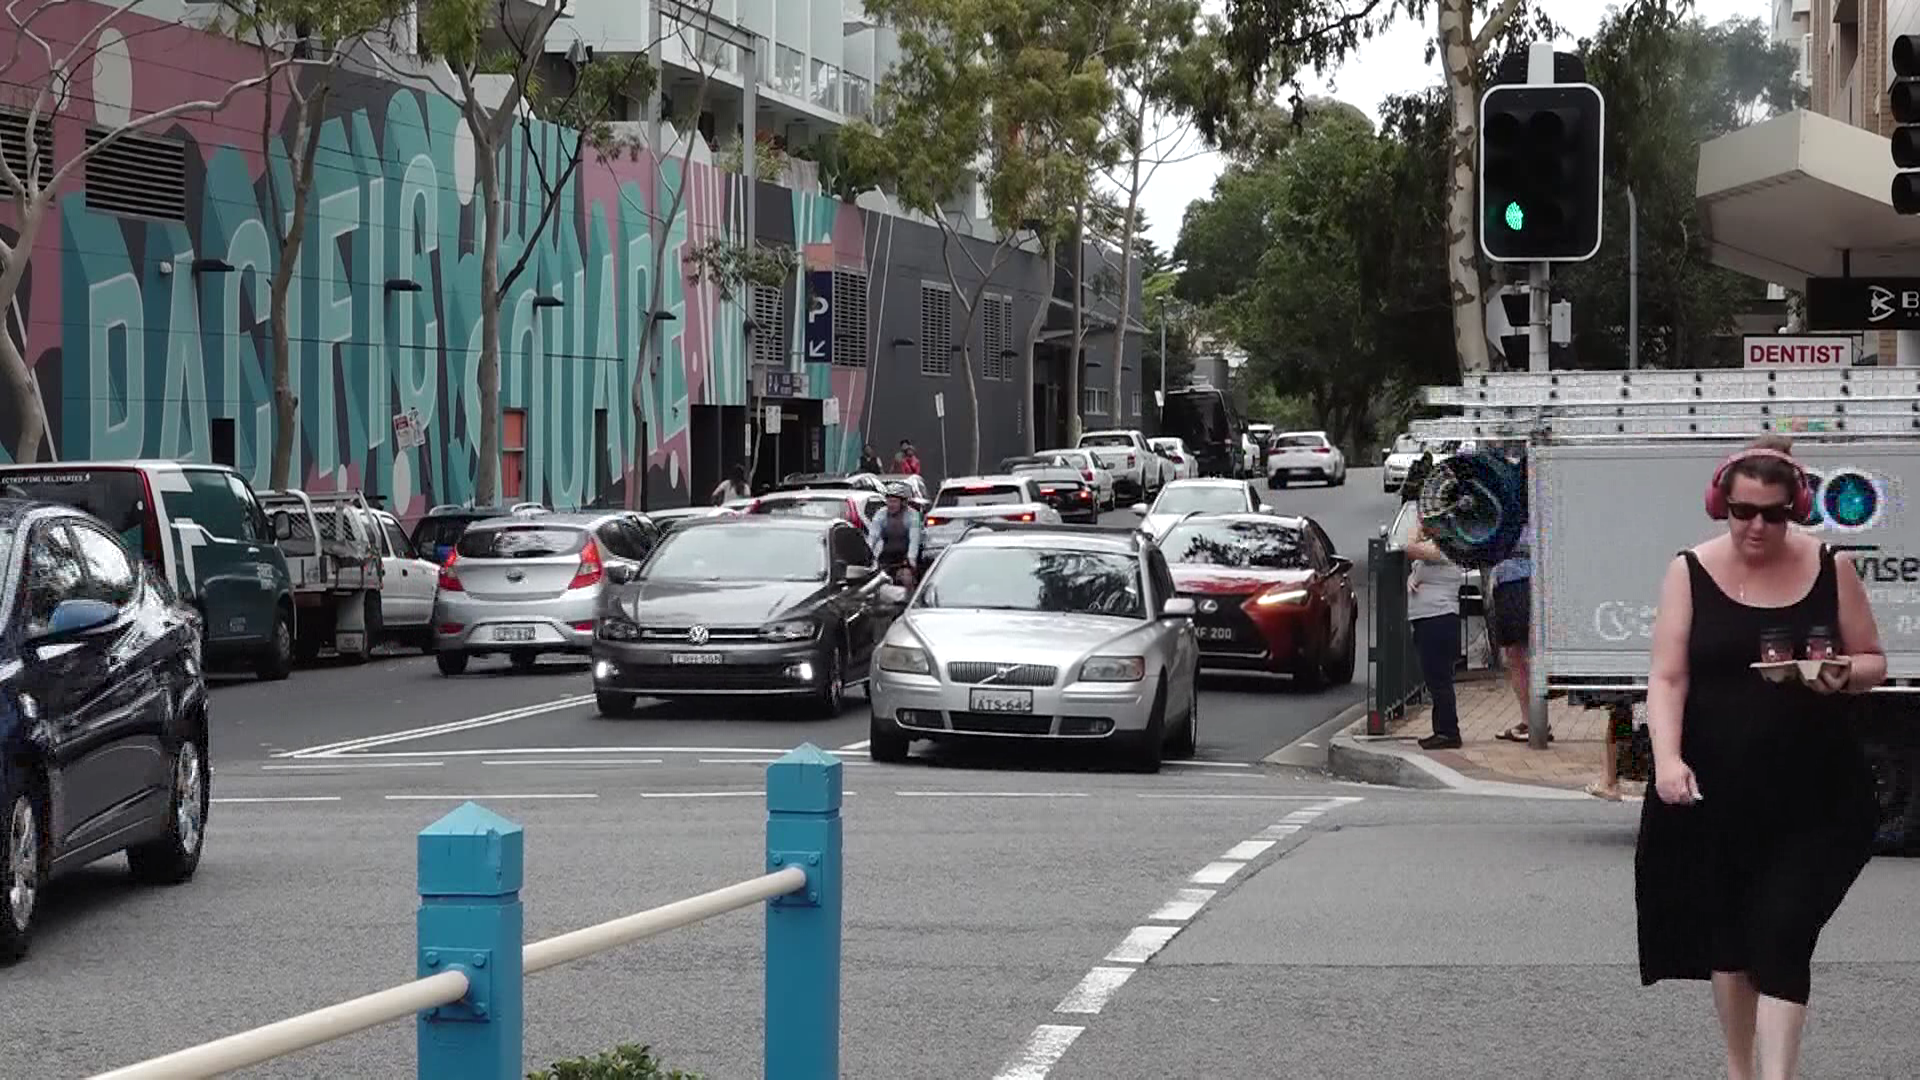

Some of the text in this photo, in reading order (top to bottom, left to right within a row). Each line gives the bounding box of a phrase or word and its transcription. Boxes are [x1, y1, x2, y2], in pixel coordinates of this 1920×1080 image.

[808, 297, 829, 323] P
[1750, 345, 1845, 363] DENTIST
[1210, 627, 1232, 639] 200
